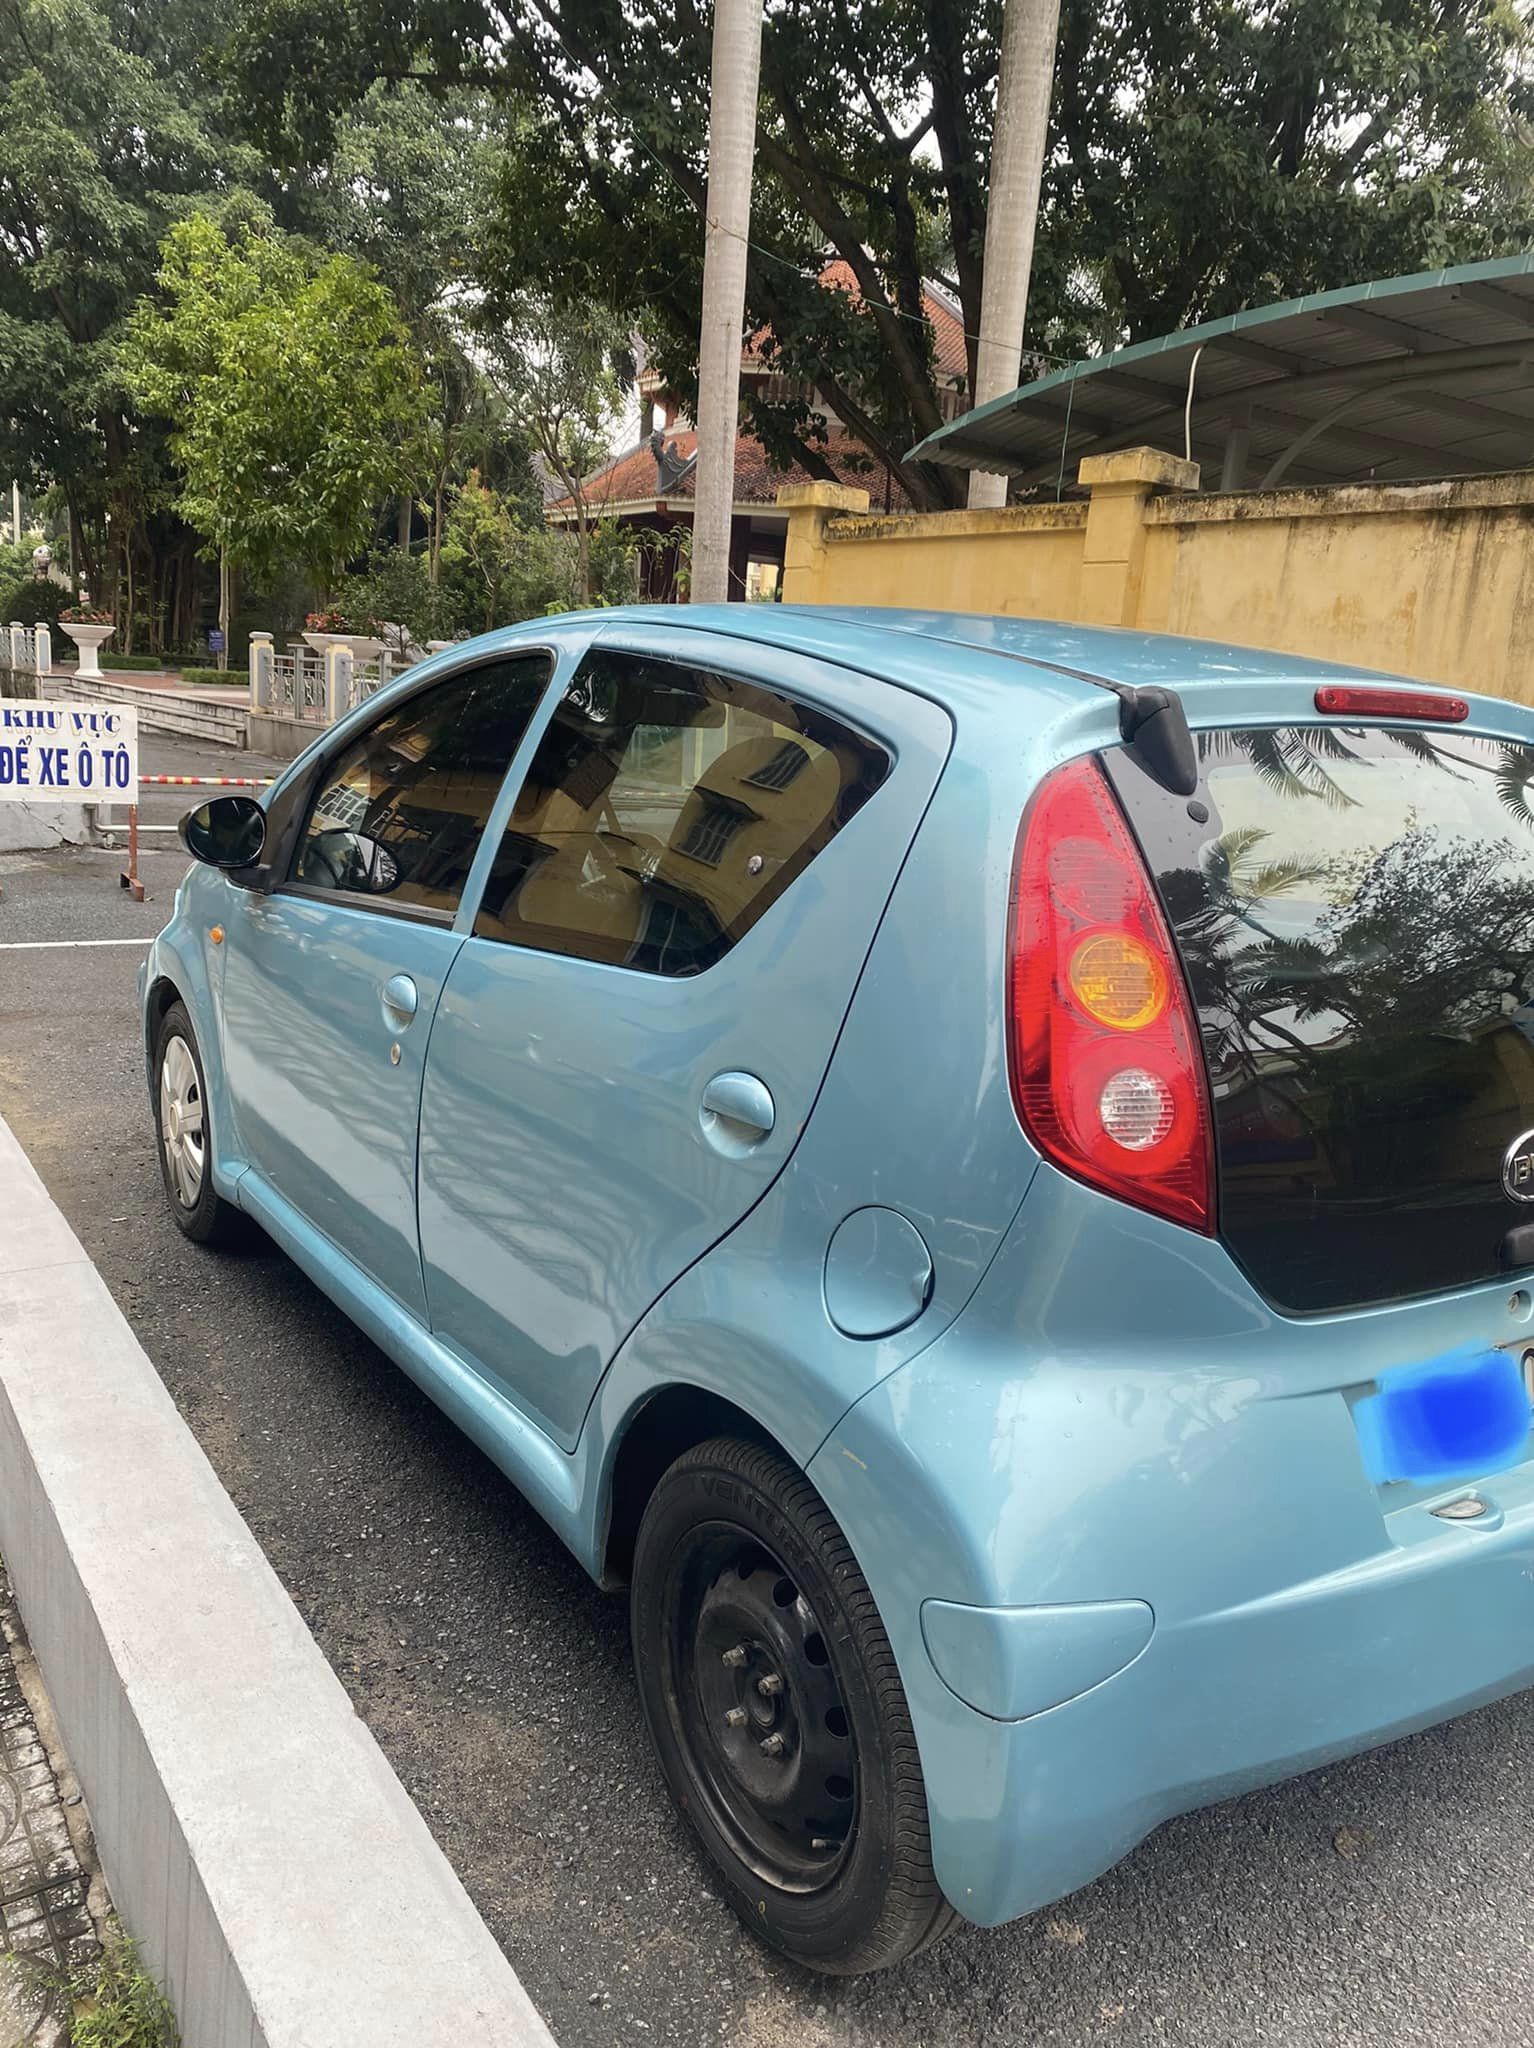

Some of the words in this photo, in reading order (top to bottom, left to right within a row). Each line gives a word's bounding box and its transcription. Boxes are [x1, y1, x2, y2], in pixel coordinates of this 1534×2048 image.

[3, 709, 62, 729] KHU
[70, 711, 121, 738] VỰC
[0, 735, 32, 785] ĐỂ
[38, 747, 70, 786] XE
[78, 741, 93, 788] Ô
[101, 742, 130, 788] TÔ
